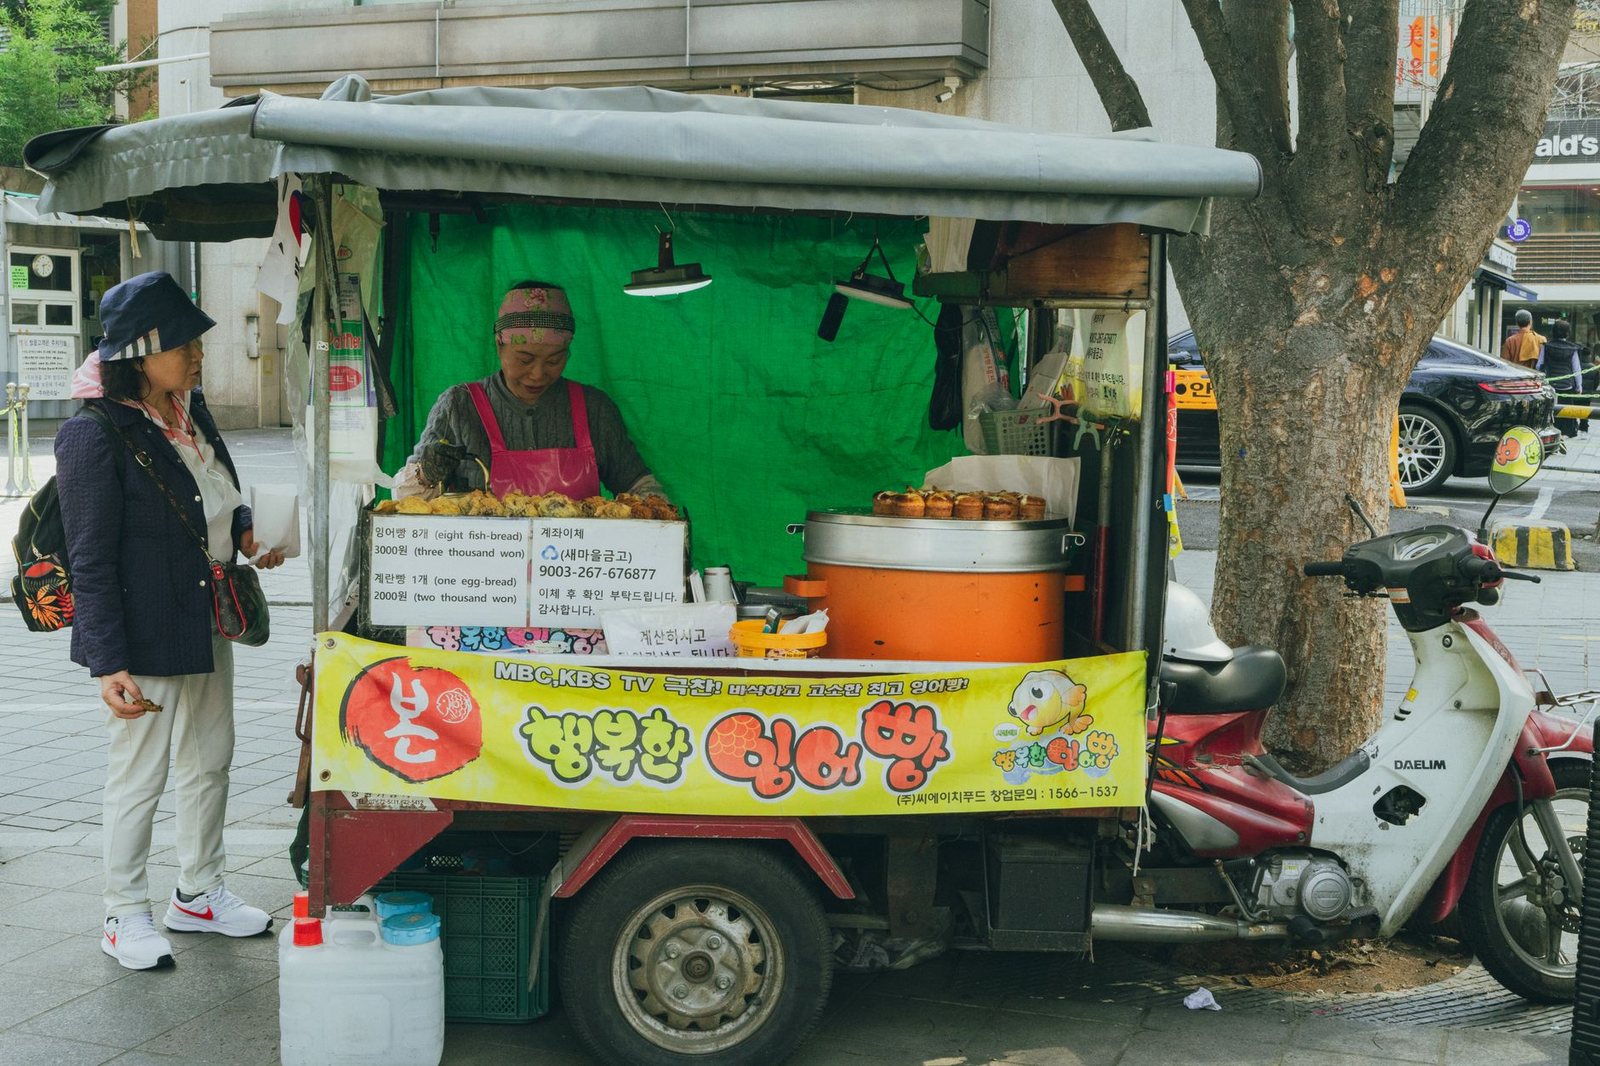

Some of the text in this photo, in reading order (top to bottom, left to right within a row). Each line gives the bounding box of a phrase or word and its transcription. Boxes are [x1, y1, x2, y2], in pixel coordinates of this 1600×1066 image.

[1535, 134, 1599, 156] ald's
[374, 527, 523, 542] 잉어빵 8개 (eight fish-bread)
[541, 527, 584, 539] 계좌이체
[374, 545, 525, 559] 3000원 (three thousand won)
[560, 548, 633, 563] (새마을금고)
[539, 565, 656, 580] 9003-267-676877
[374, 573, 517, 588] 계란빵 1개 (one egg-bread)
[374, 591, 517, 605] 2000원 (two thousand won)
[538, 588, 678, 603] 이체 후 확인 부탁드립니다.
[538, 604, 596, 616] 감사합니다.
[494, 661, 969, 697] MBC,KBS TV 극찬! 바삭하고 고소한 최고 잉어빵!
[384, 672, 438, 764] 본
[518, 699, 952, 797] 행복한 잉어빵
[992, 730, 1119, 772] 행복한 잉어빵
[1394, 760, 1447, 770] DAELIM
[896, 790, 987, 806] (주)씨에이치푸드
[990, 788, 1037, 803] 창업문의
[1048, 786, 1119, 800] 1566-1537
